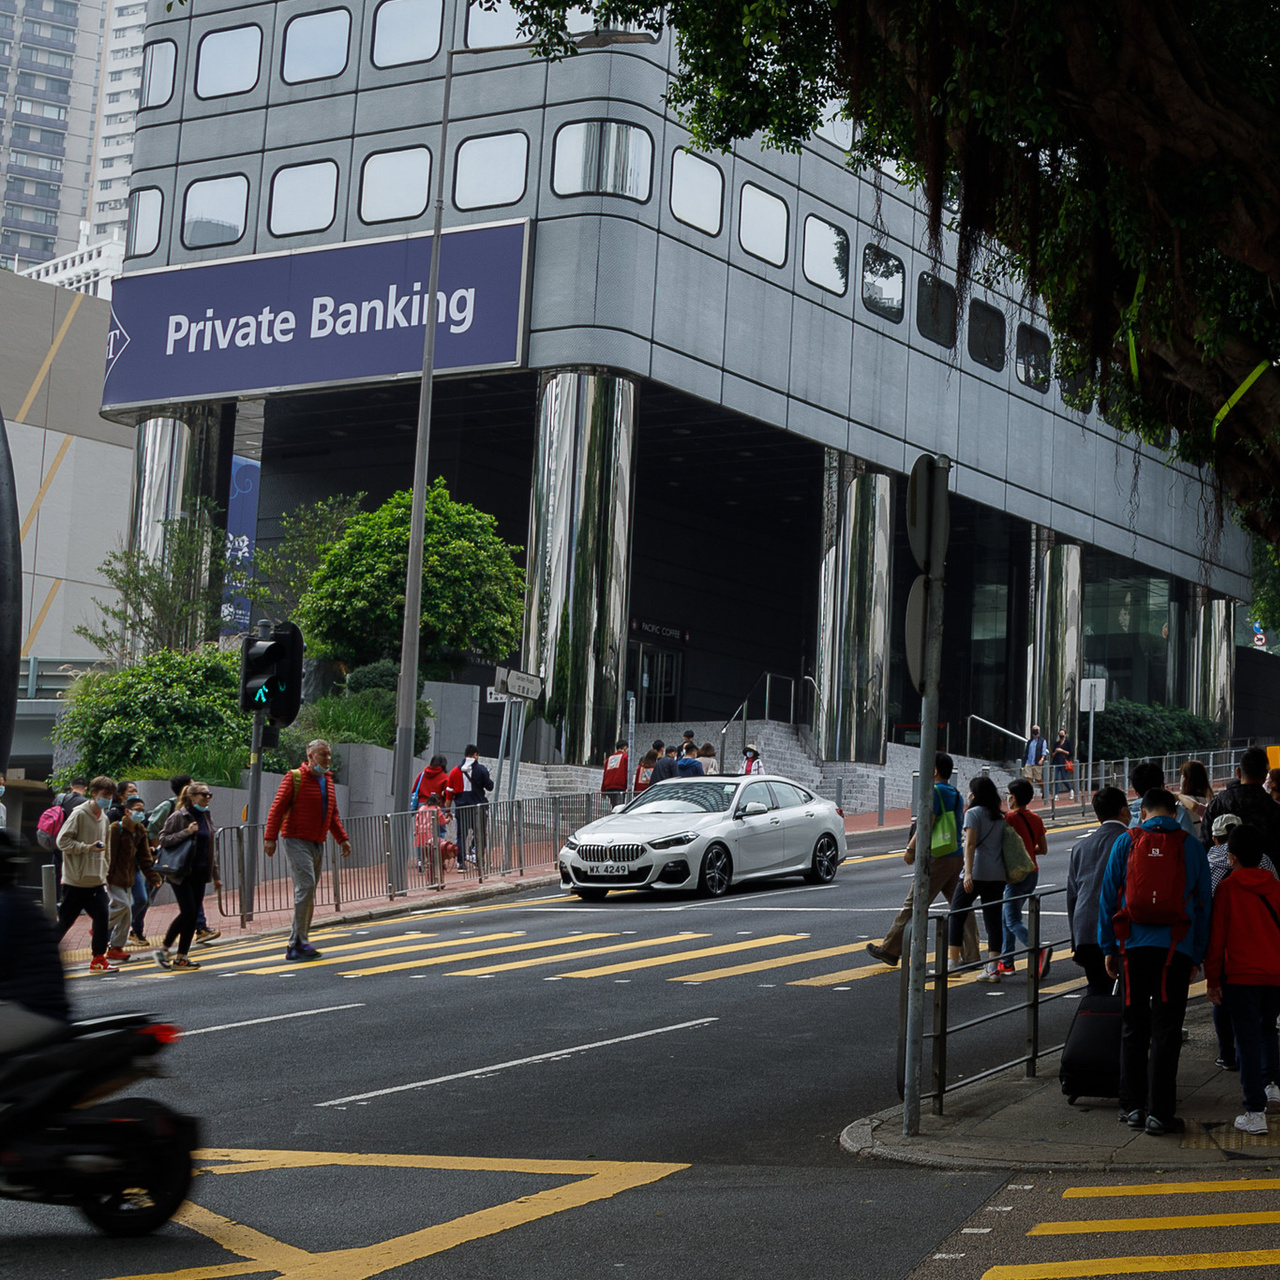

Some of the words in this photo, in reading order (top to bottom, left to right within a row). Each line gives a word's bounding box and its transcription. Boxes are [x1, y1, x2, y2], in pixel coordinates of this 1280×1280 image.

[165, 308, 296, 355] Private
[309, 281, 476, 338] Banking
[642, 622, 660, 635] PACIFIC
[661, 627, 681, 639] COFFEE
[604, 866, 626, 874] 4249
